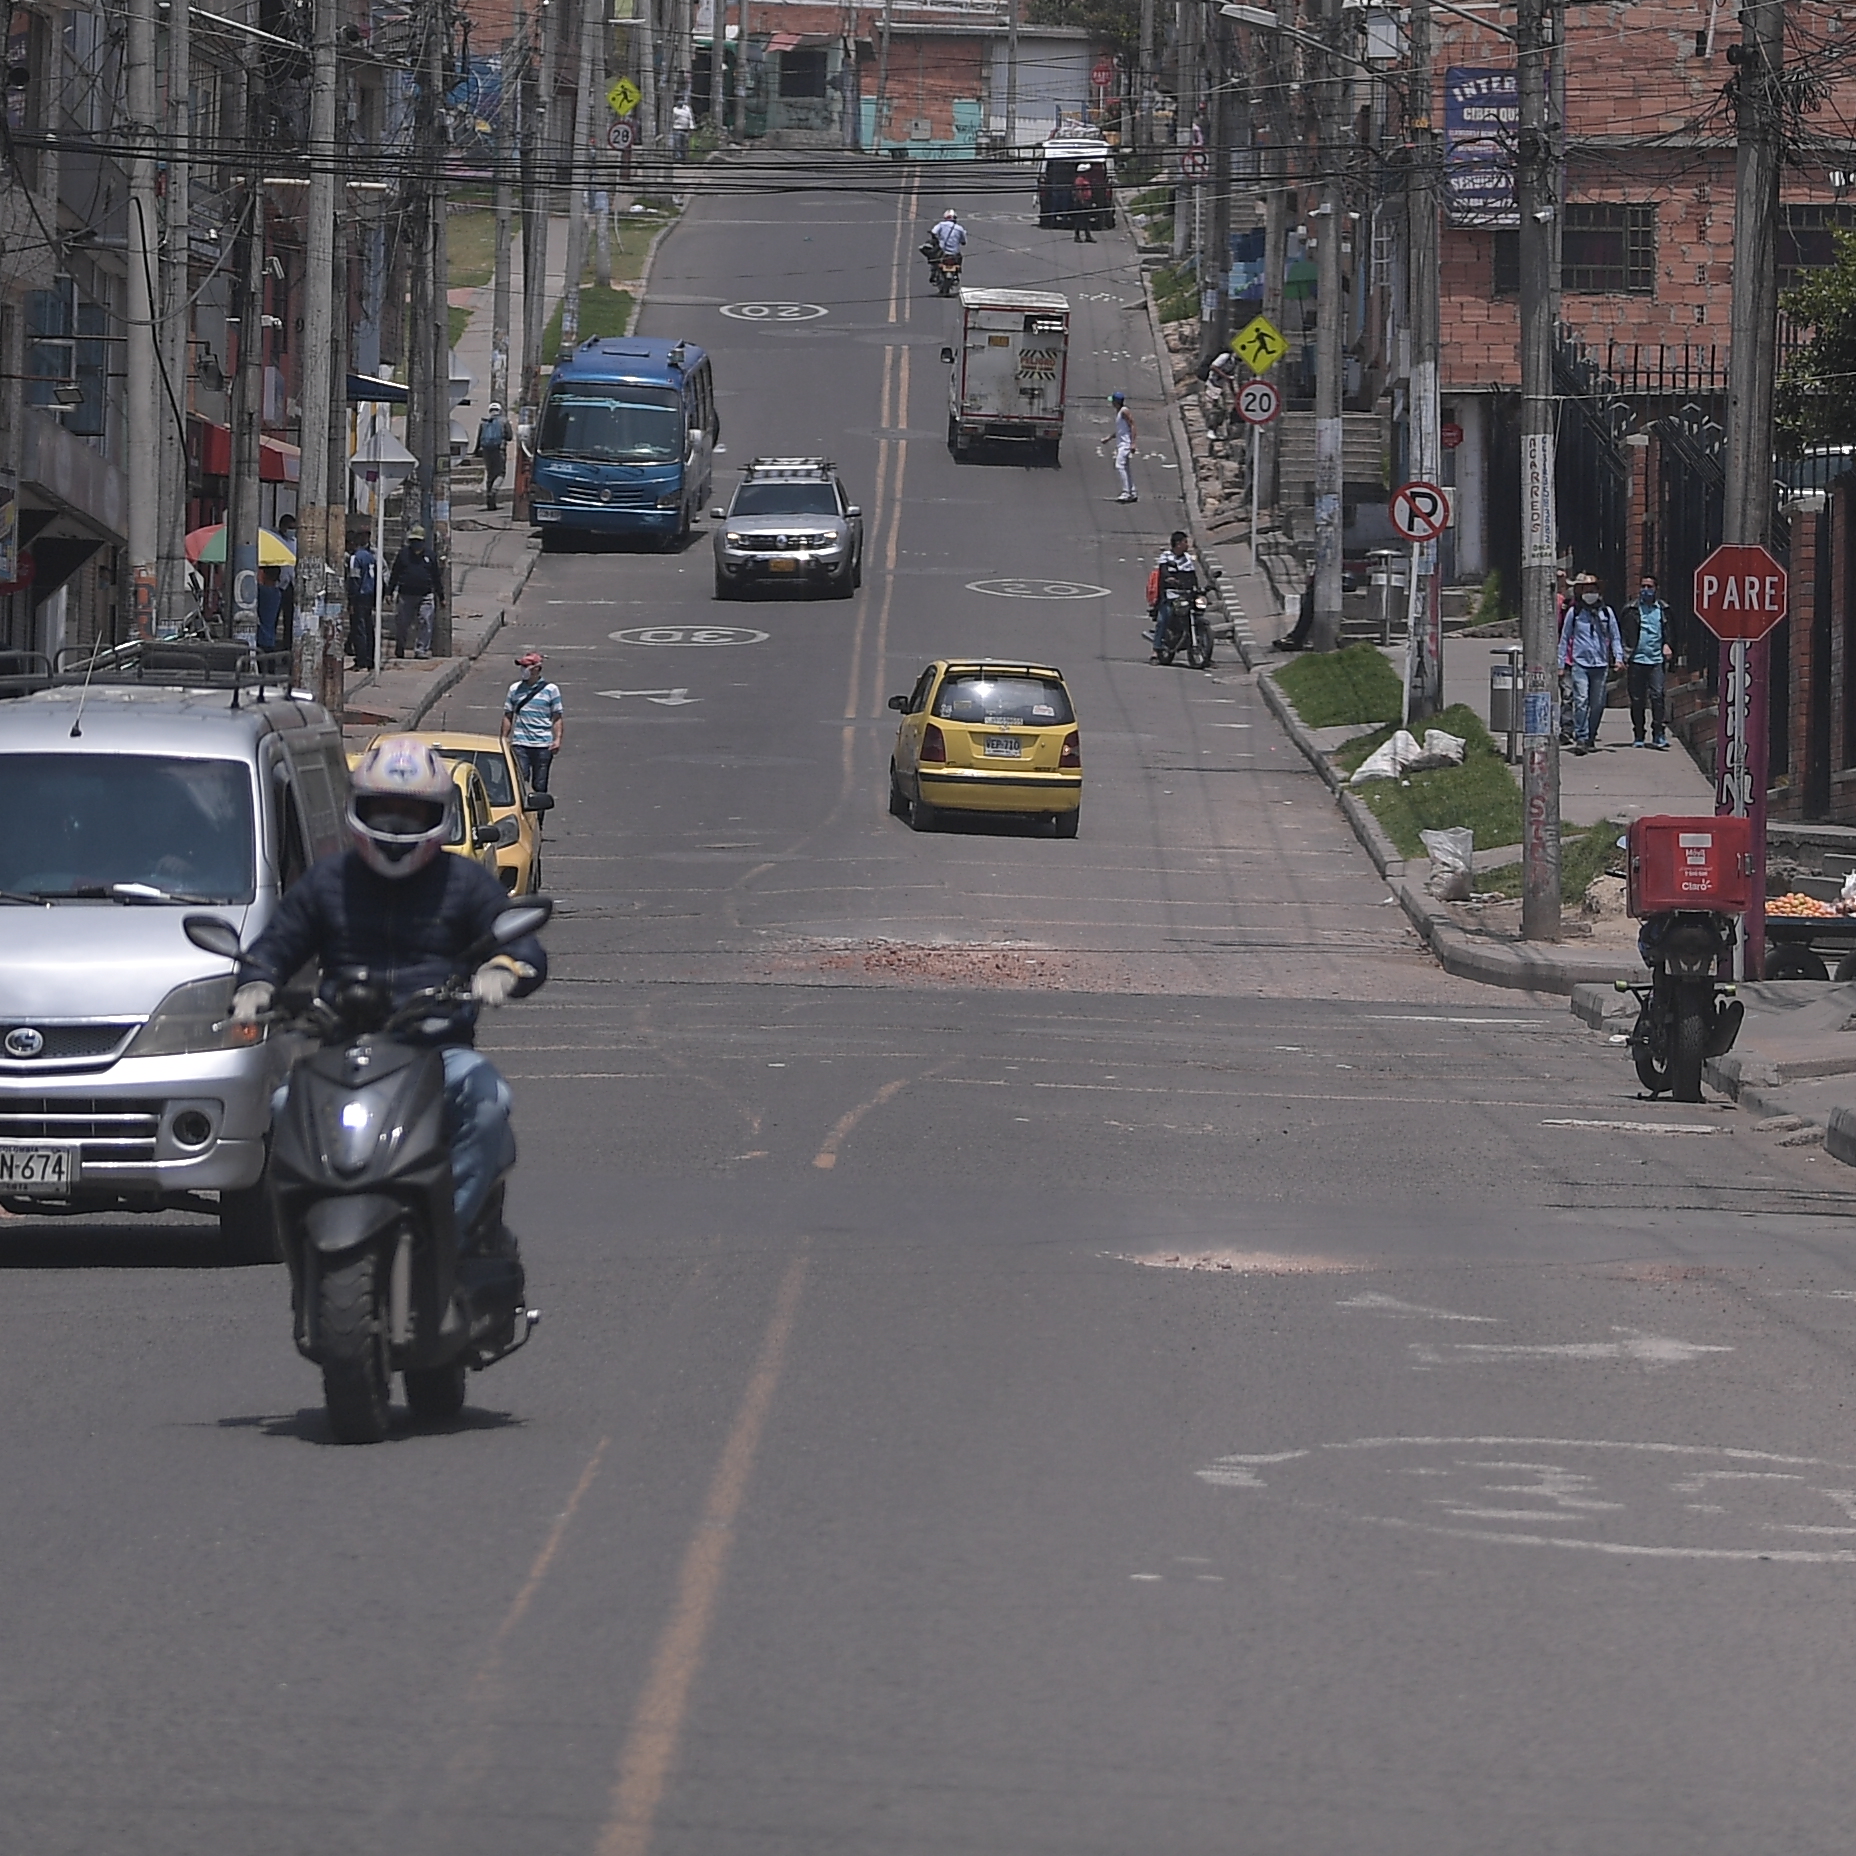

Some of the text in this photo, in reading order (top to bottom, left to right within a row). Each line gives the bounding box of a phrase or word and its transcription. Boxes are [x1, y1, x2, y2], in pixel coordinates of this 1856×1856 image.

[1244, 392, 1272, 414] 20
[1001, 584, 1080, 596] 20
[1702, 575, 1779, 611] PARE
[1681, 881, 1707, 891] Claro
